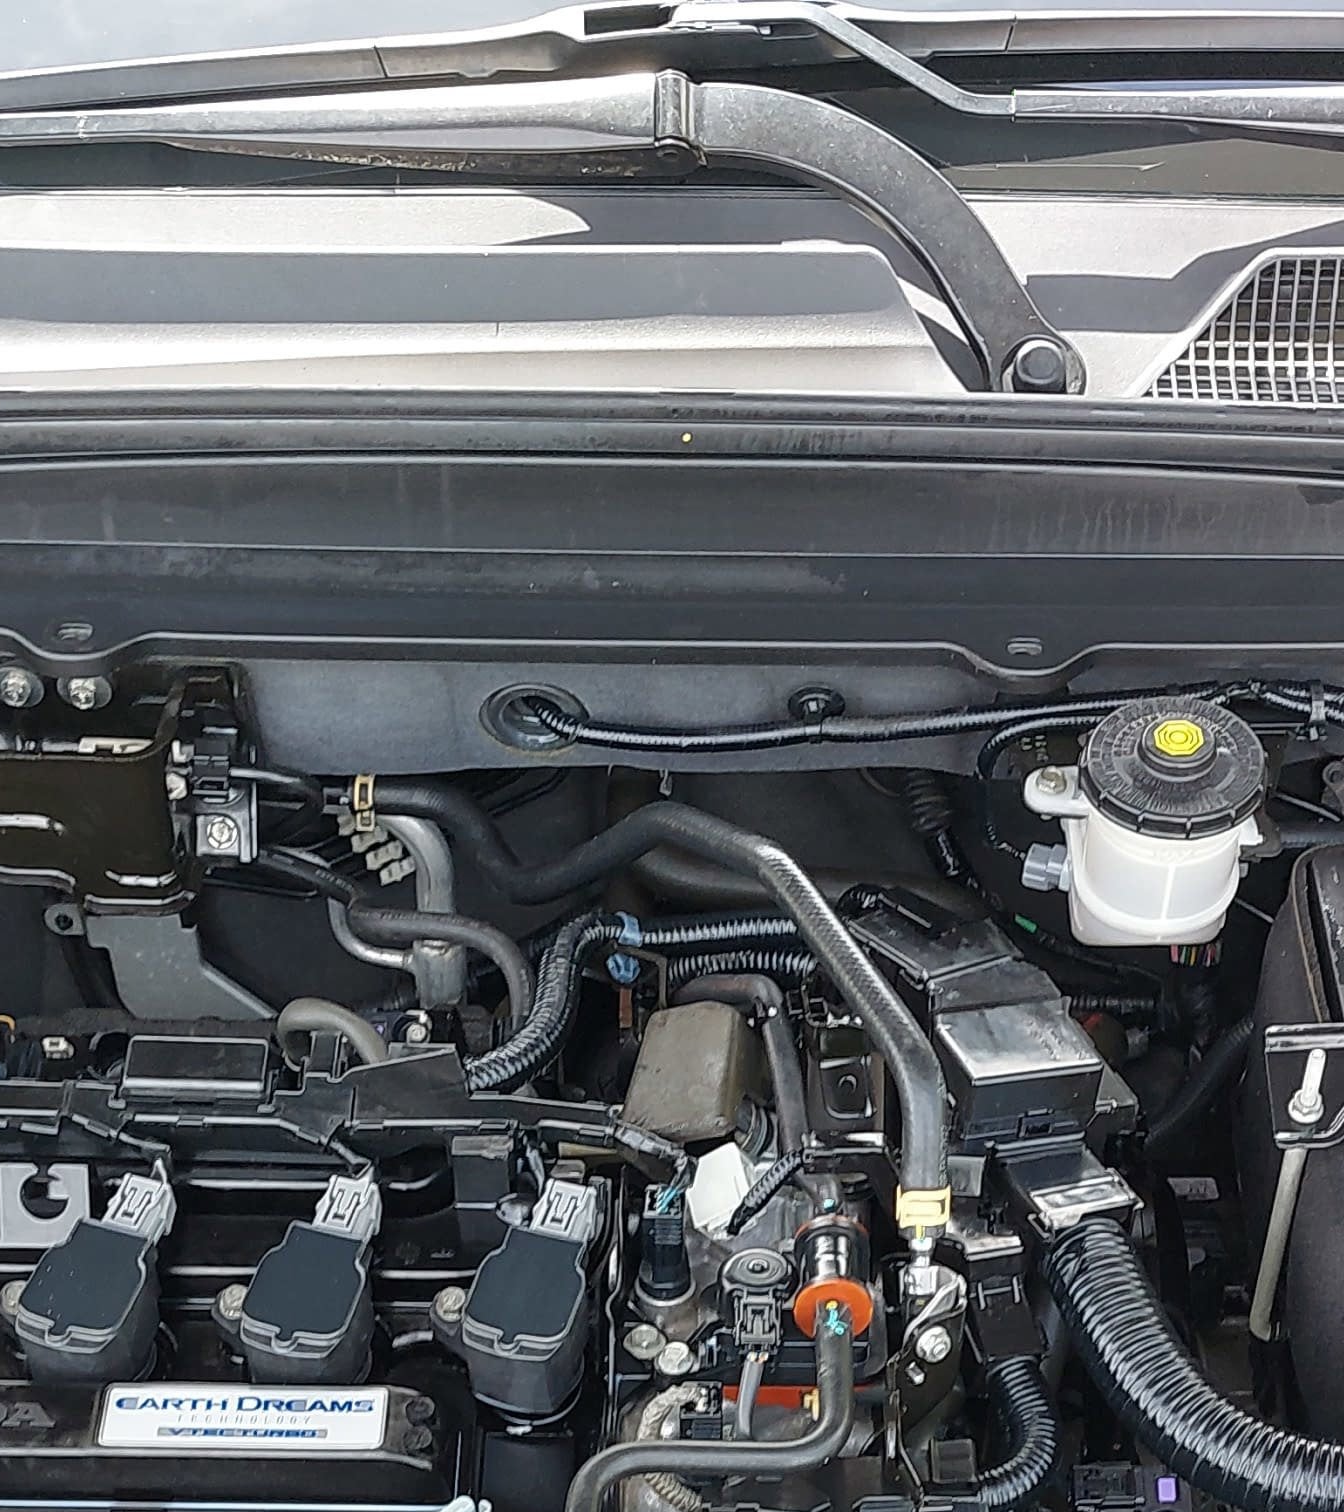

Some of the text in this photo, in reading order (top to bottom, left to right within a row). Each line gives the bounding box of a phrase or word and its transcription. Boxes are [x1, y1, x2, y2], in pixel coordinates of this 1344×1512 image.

[115, 1396, 375, 1413] EARTH DREAMS
[176, 1414, 311, 1425] TECHNOLOGY
